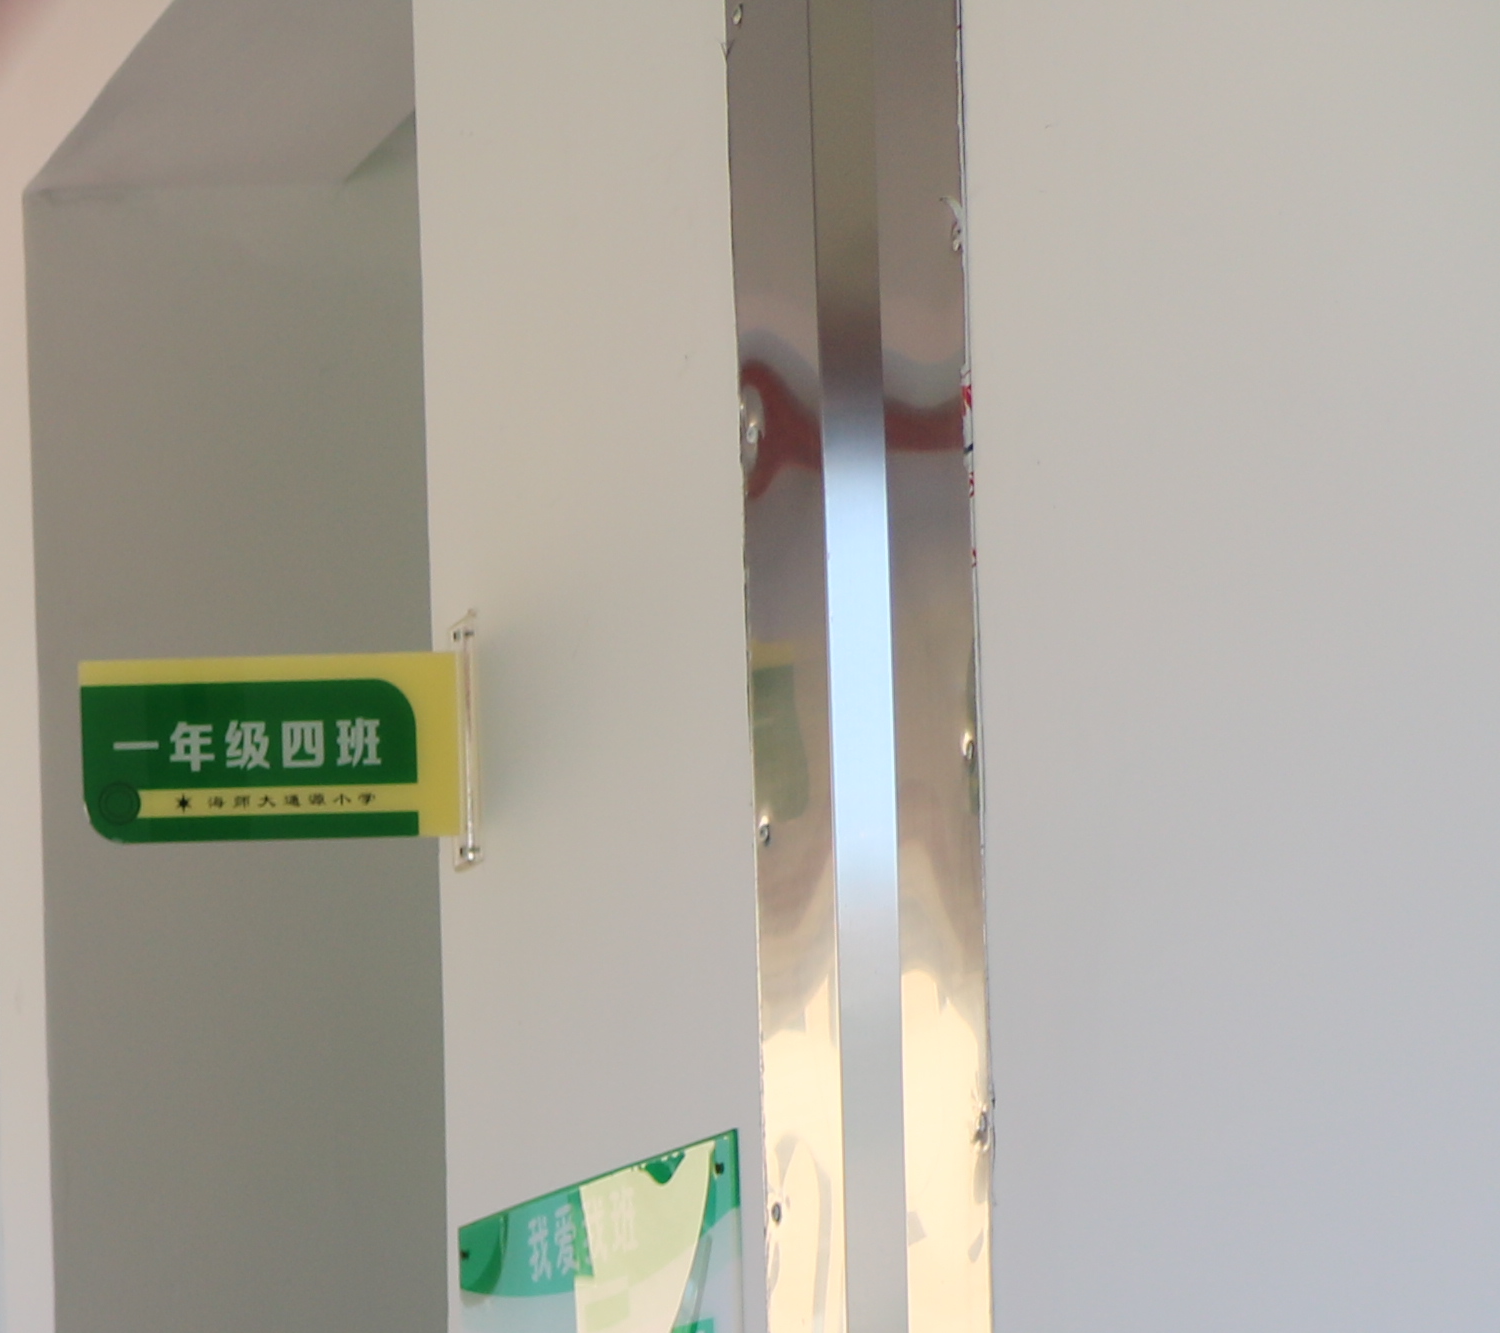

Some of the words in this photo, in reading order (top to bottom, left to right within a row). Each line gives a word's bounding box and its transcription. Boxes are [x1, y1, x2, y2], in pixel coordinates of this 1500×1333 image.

[113, 718, 382, 771] 一年级四班
[526, 1187, 638, 1282] 我爱我班
